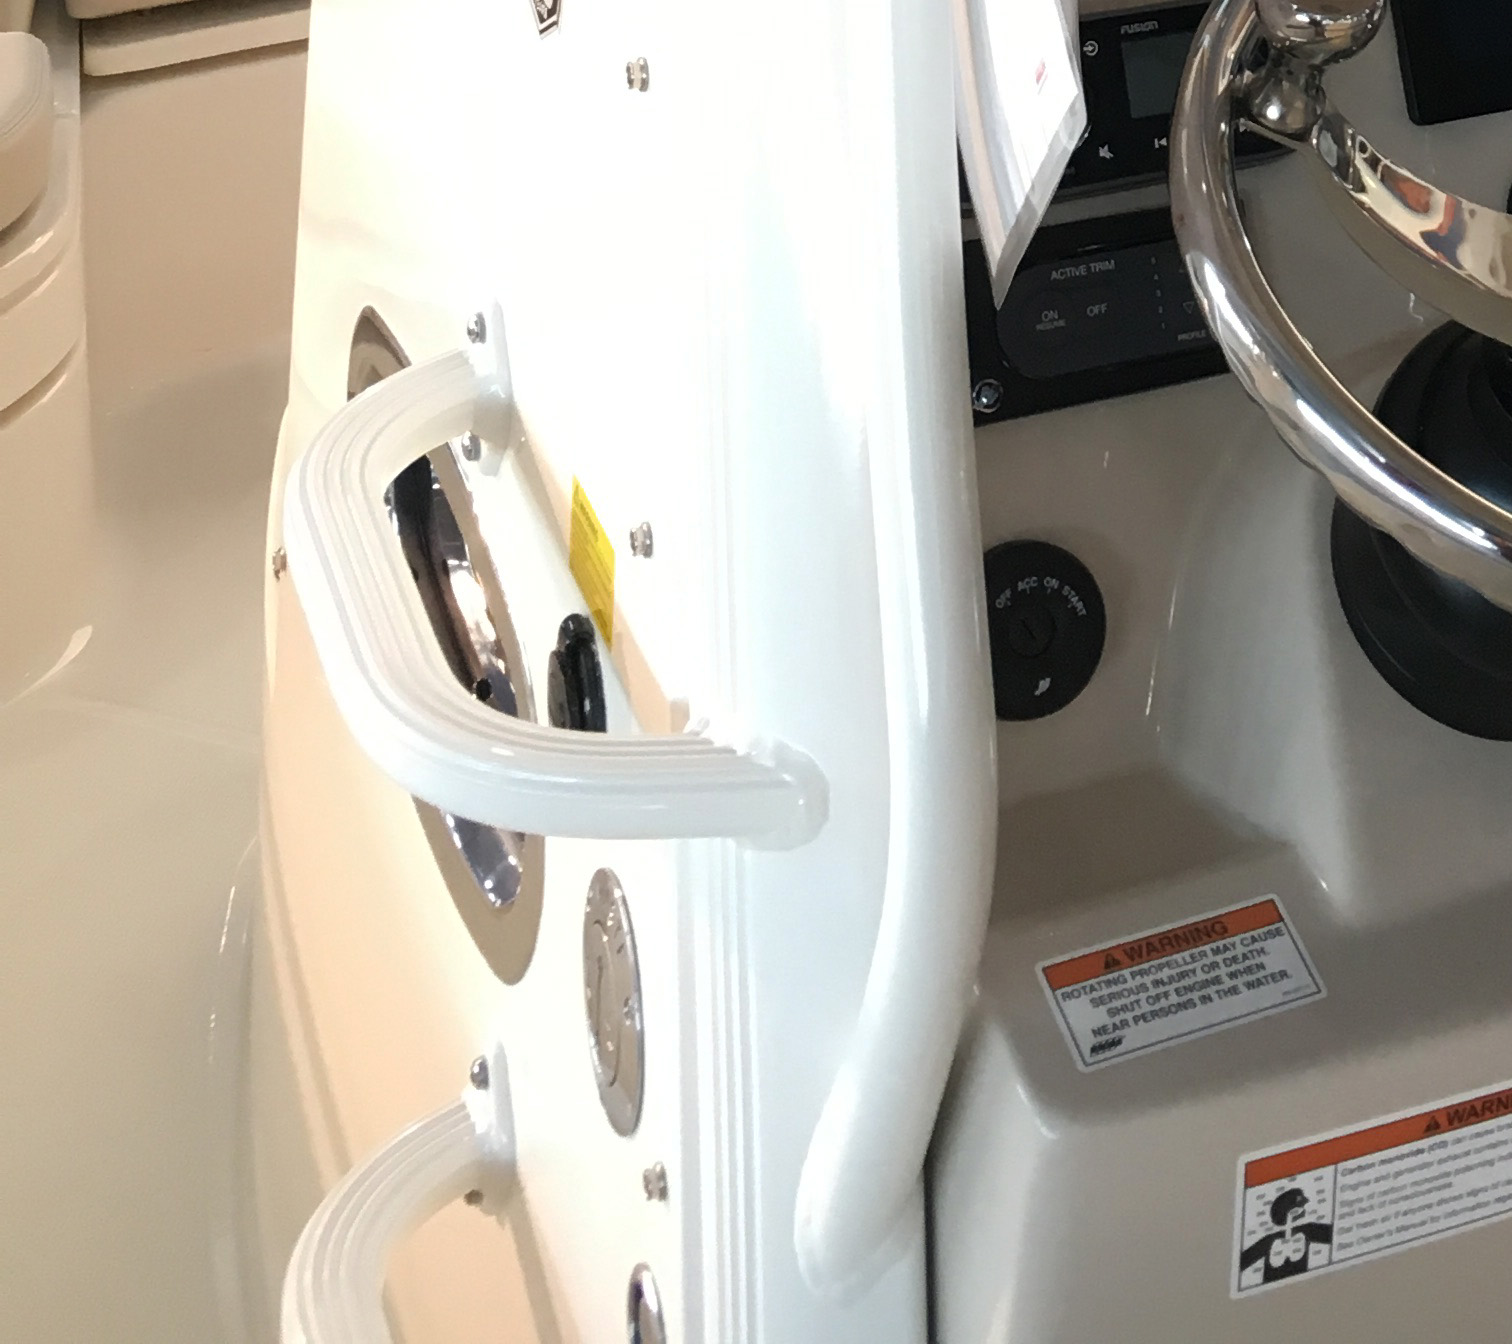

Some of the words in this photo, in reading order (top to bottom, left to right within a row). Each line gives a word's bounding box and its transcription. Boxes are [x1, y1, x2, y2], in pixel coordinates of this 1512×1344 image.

[1050, 264, 1088, 281] ACTIVE
[1089, 259, 1115, 273] TRIM
[1042, 310, 1058, 322] ON
[1087, 303, 1108, 317] OFF
[995, 588, 1012, 609] OFF
[1018, 577, 1038, 591] ACC
[1044, 576, 1059, 590] ON
[1062, 585, 1087, 617] START
[1059, 973, 1128, 1002] ROTATING
[1128, 949, 1208, 981] PROPELLER
[1209, 940, 1238, 956] MAY
[1238, 925, 1285, 947] CAUSE
[1121, 919, 1230, 963] WARNING
[1089, 981, 1150, 1008] SERIOUS
[1149, 966, 1199, 989] INJURY
[1199, 959, 1221, 974] OR
[1105, 998, 1144, 1018] SHUT
[1144, 989, 1173, 1006] OFF
[1172, 973, 1225, 997] ENGINE
[1224, 960, 1267, 981] WHEN
[1090, 1017, 1131, 1038] NEAR
[1131, 997, 1197, 1026] PERSONS
[1197, 992, 1214, 1005] IN
[1213, 983, 1241, 1000] THE
